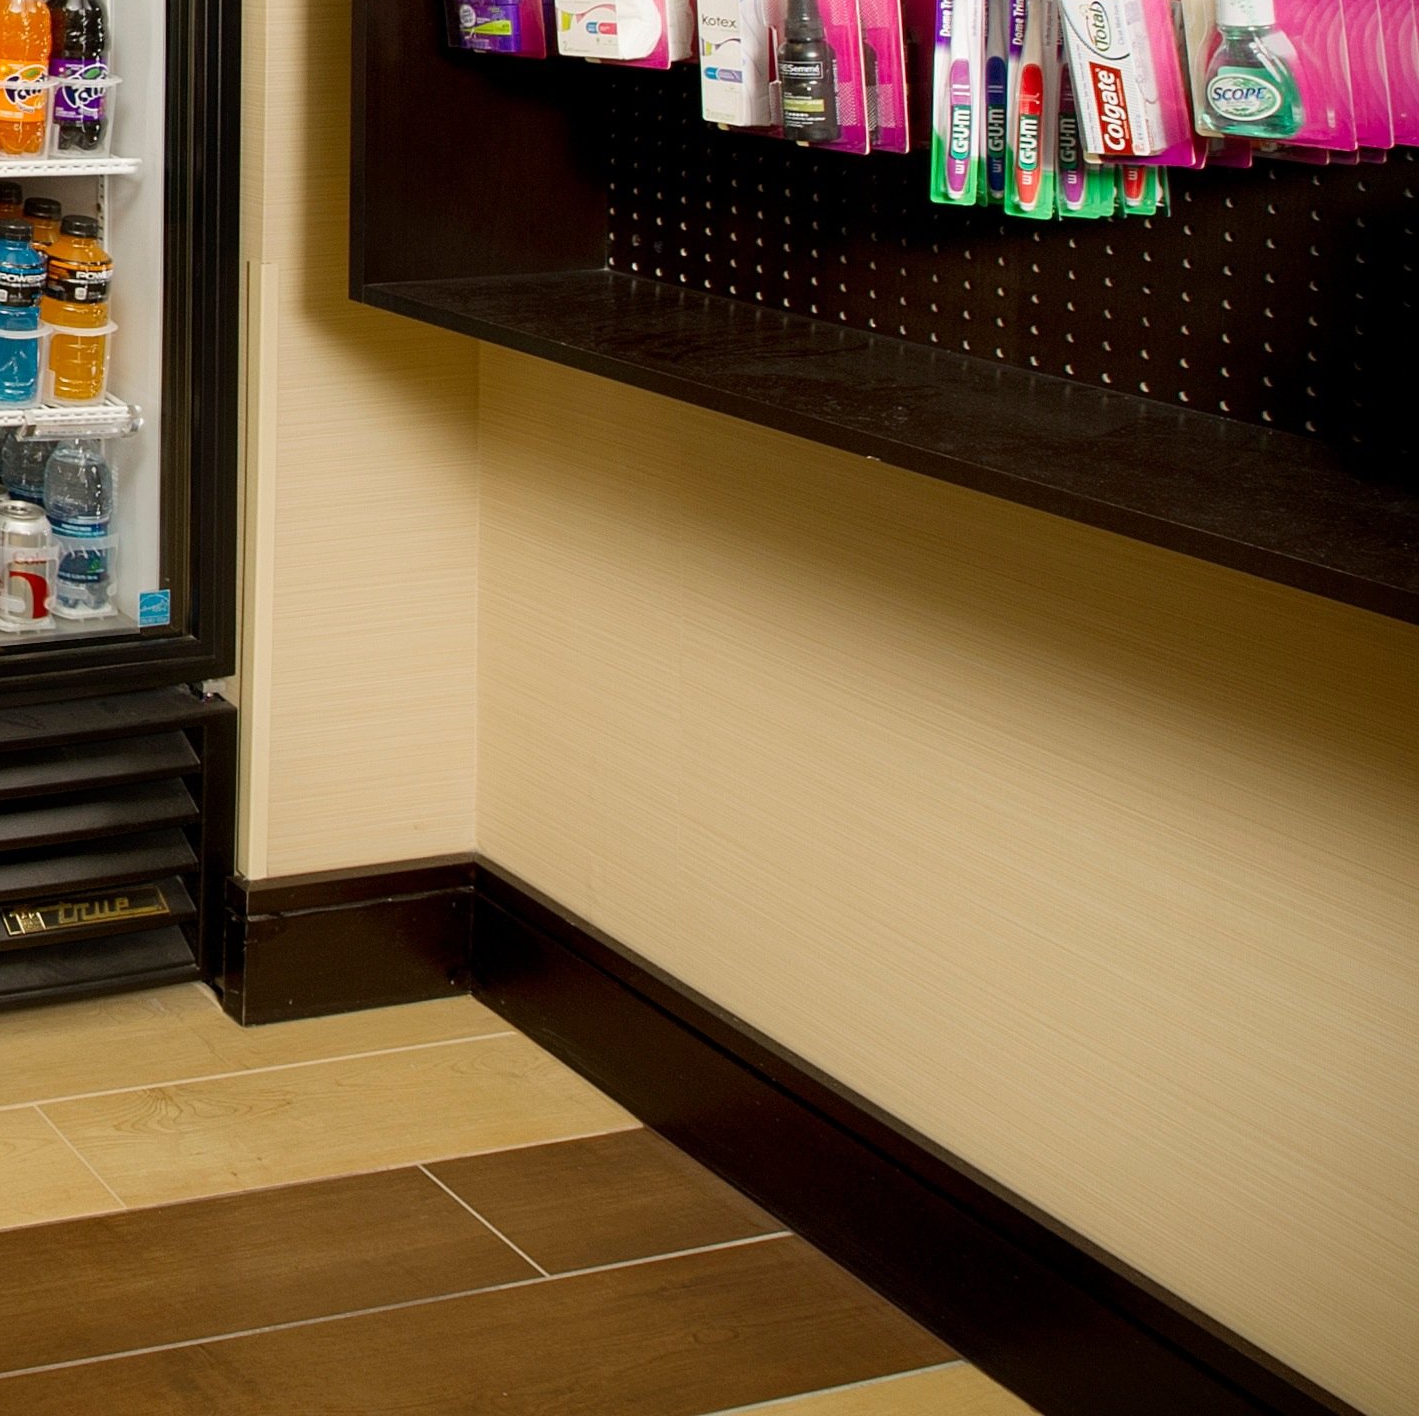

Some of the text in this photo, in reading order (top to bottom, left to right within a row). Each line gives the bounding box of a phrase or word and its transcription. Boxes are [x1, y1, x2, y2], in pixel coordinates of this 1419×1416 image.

[940, 11, 951, 38] Dome
[1012, 18, 1024, 47] Dome
[1089, 0, 1111, 52] Total
[1212, 84, 1268, 103] SCOPE
[1101, 68, 1128, 152] Colgate
